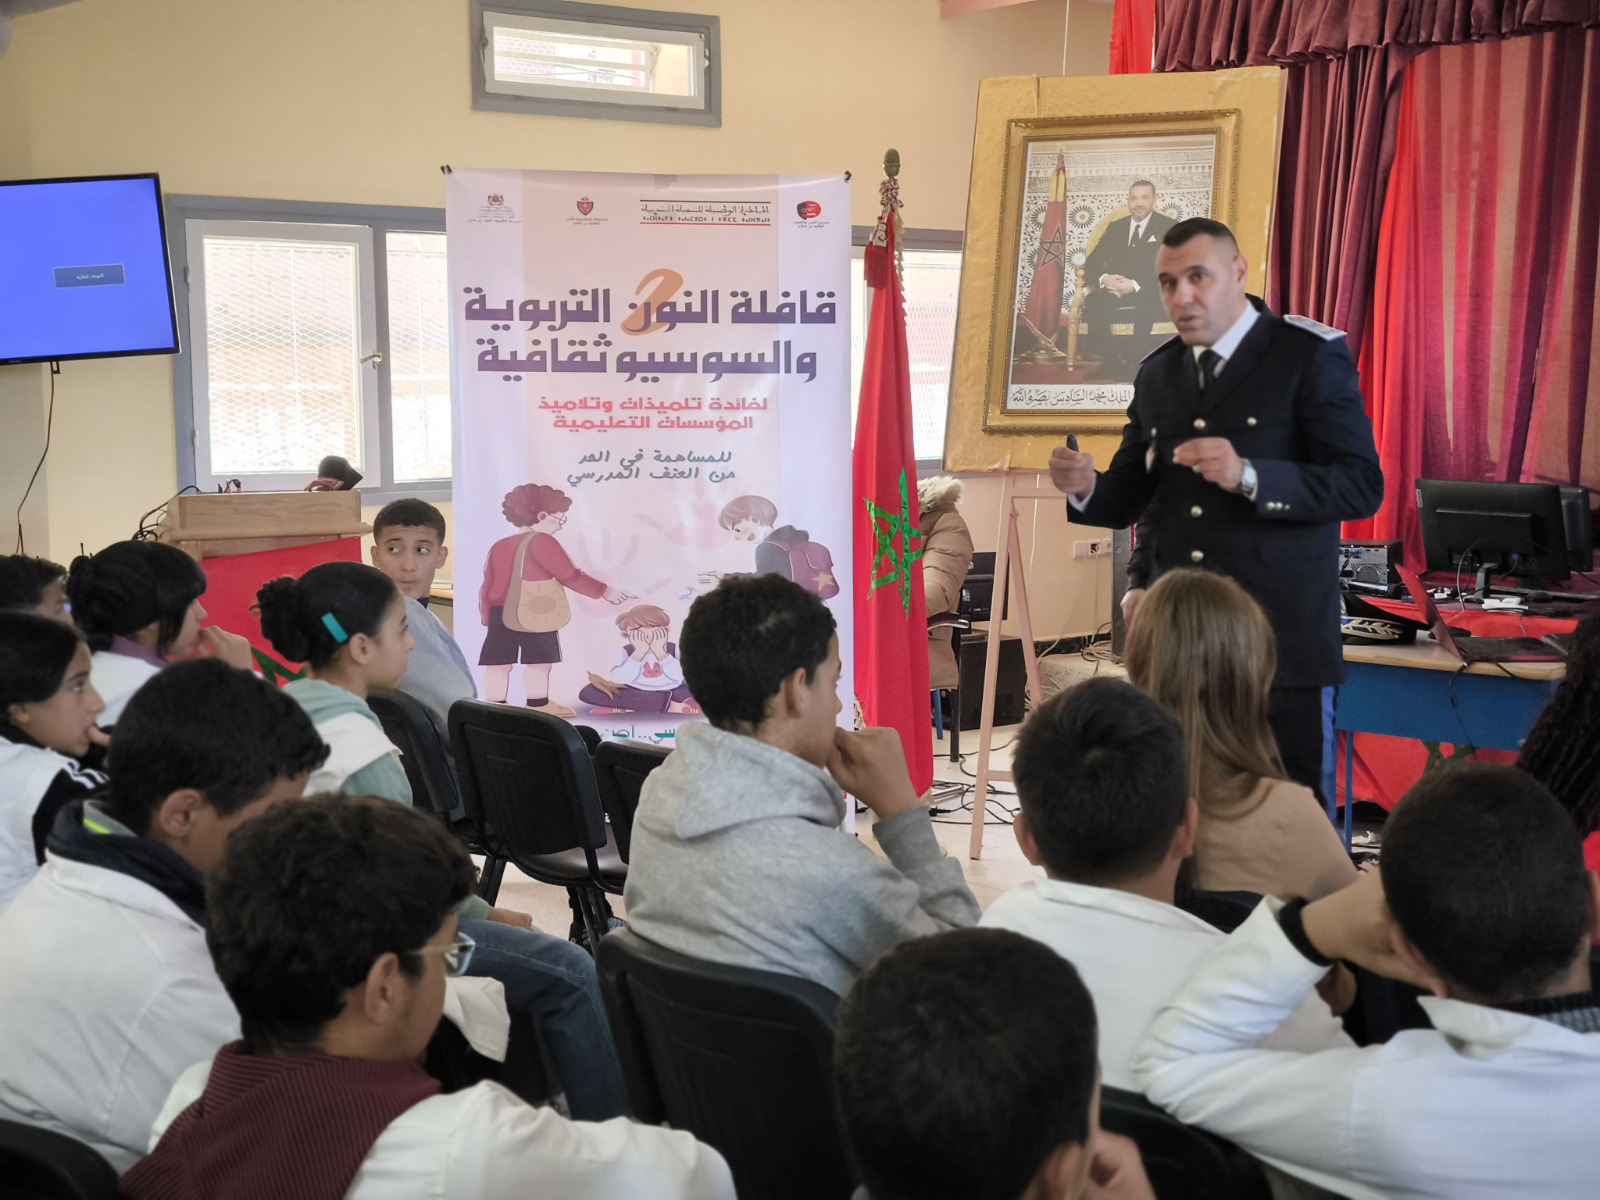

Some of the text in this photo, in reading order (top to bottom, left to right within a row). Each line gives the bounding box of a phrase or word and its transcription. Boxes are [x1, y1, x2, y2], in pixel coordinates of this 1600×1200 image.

[464, 287, 837, 332] قافلة النون التربوية
[538, 396, 768, 414] لفائدة تلميذات وتلاميذ
[553, 415, 754, 433] المؤسسات التعليمية
[619, 448, 644, 469] في
[652, 450, 732, 463] للمساهمة
[566, 466, 736, 488] من العنف المدرسي
